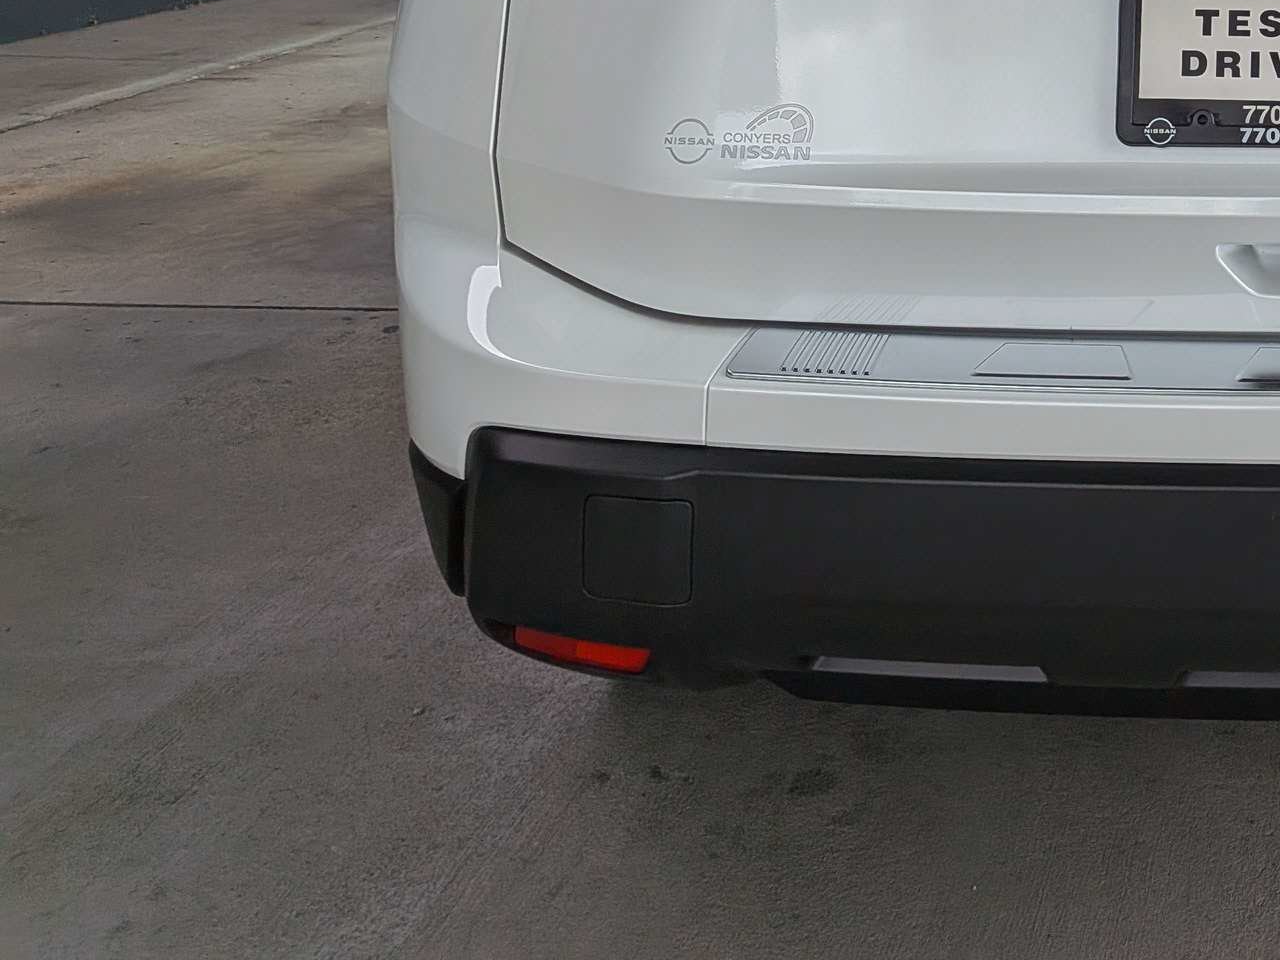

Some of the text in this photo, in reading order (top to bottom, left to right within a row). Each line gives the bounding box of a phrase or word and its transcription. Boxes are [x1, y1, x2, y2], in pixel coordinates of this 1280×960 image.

[664, 136, 716, 146] NISSAN
[722, 132, 791, 144] CONYERS
[720, 144, 811, 161] NISSAN
